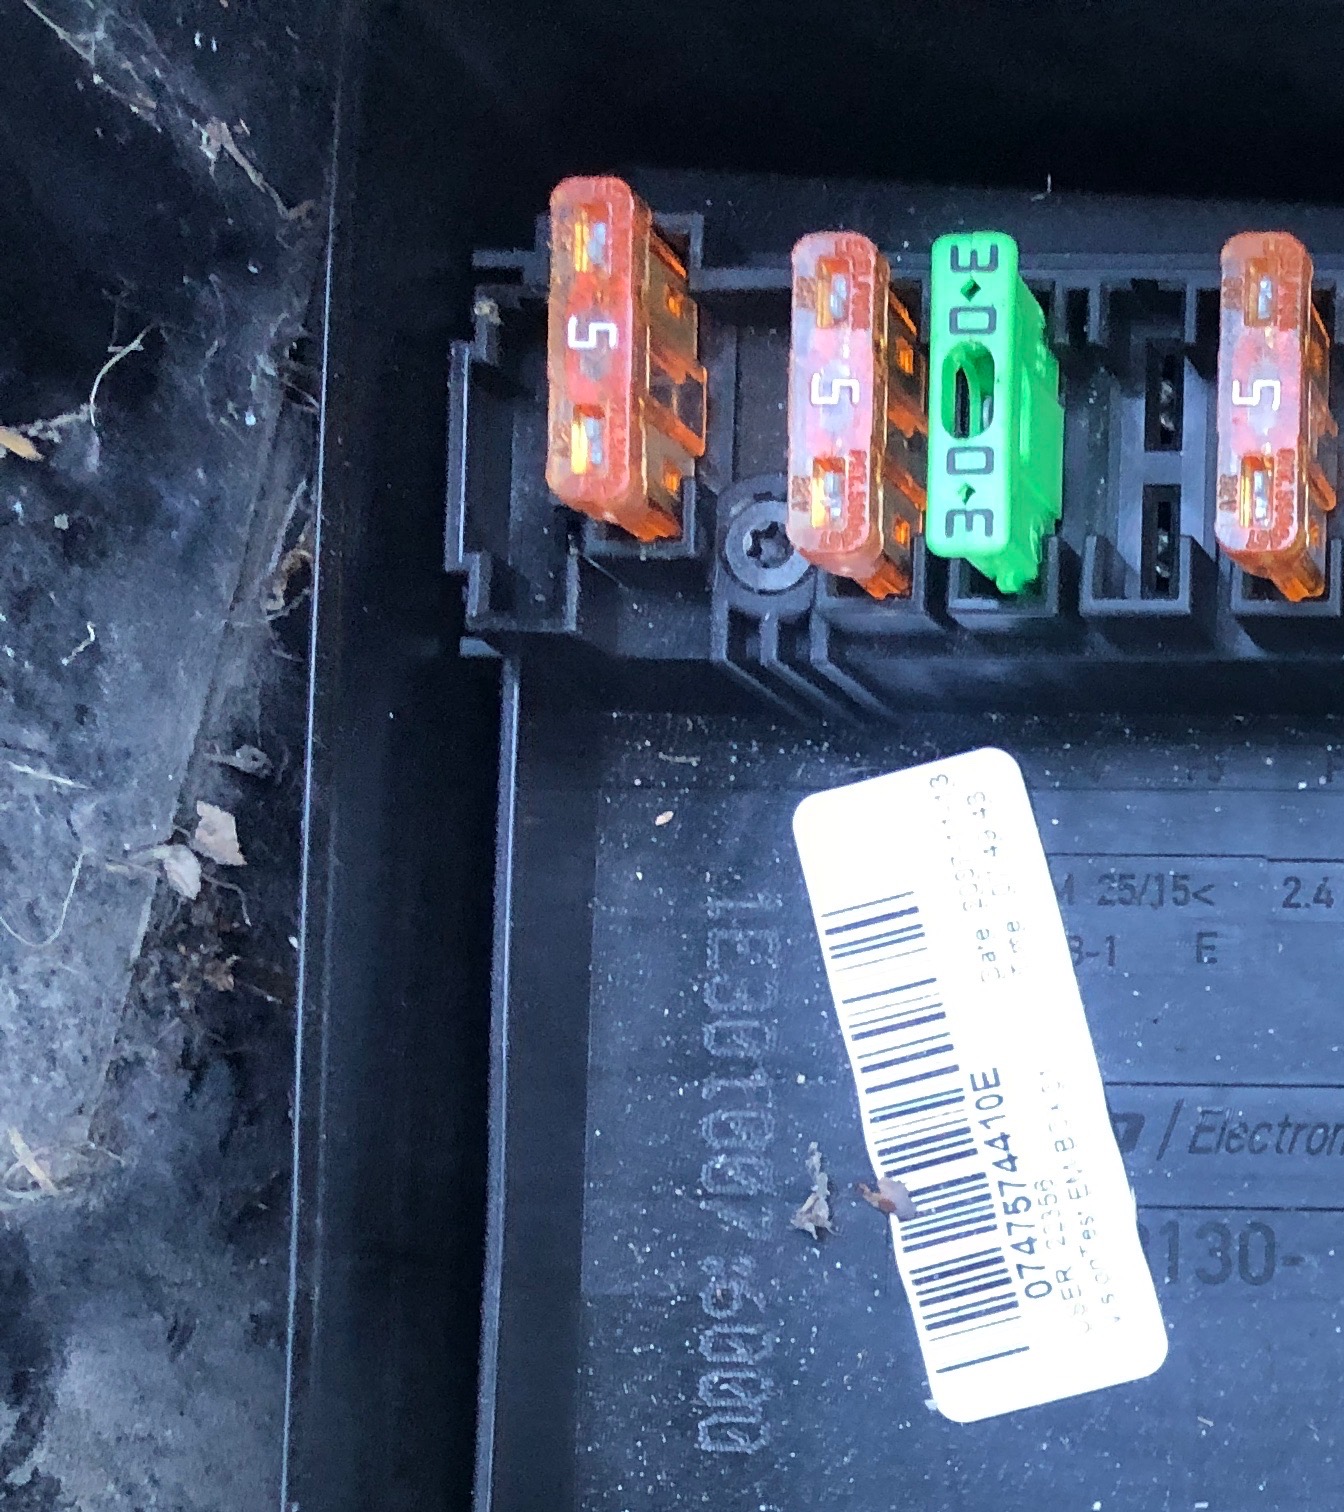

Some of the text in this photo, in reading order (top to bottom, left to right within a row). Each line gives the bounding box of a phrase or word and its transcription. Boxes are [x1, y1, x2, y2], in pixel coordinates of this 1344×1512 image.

[568, 315, 620, 351] 5
[810, 372, 860, 407] 5
[1232, 378, 1281, 413] 5
[1281, 874, 1335, 911] 2.4
[1003, 918, 1030, 974] Tme
[1196, 930, 1220, 964] E
[968, 1065, 1053, 1301] 0747574410E
[1141, 1218, 1306, 1287] 130-
